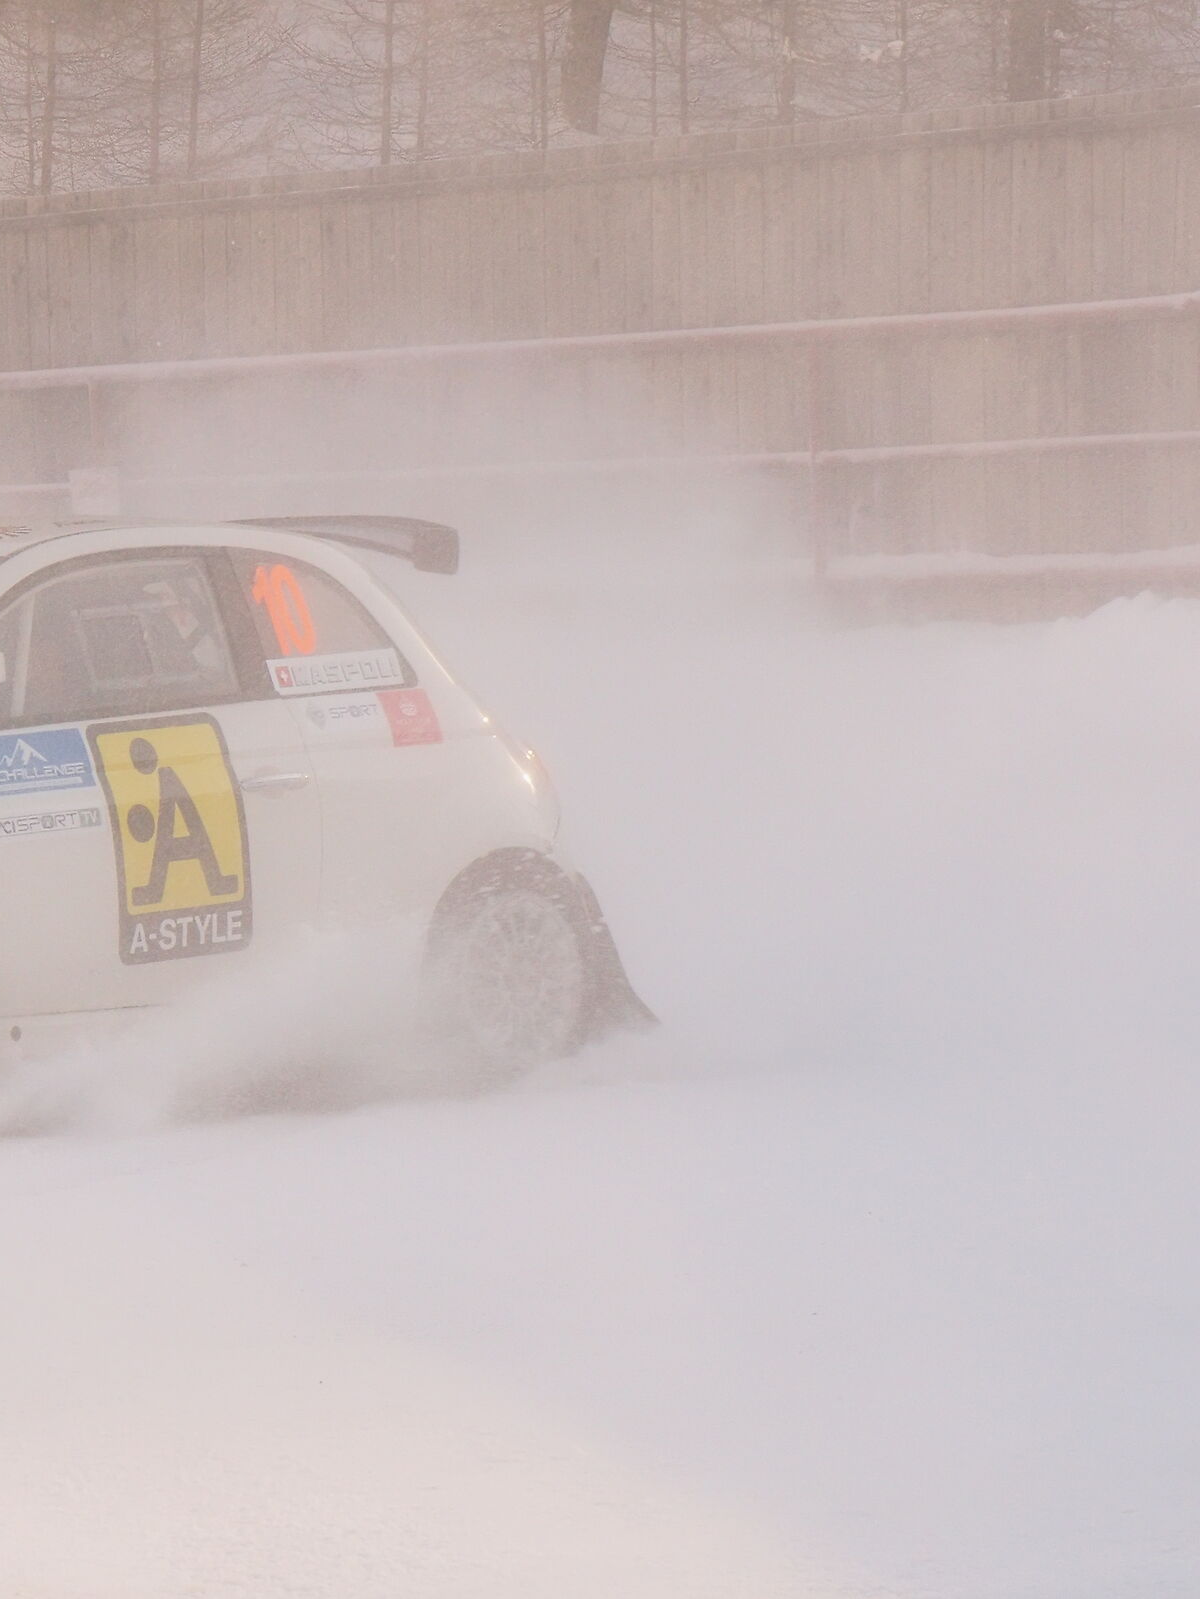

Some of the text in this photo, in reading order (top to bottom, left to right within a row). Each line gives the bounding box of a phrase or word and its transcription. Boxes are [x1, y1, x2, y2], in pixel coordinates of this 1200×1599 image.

[251, 563, 317, 657] 10
[327, 702, 381, 720] SPORT
[129, 909, 244, 955] A-STYLE
